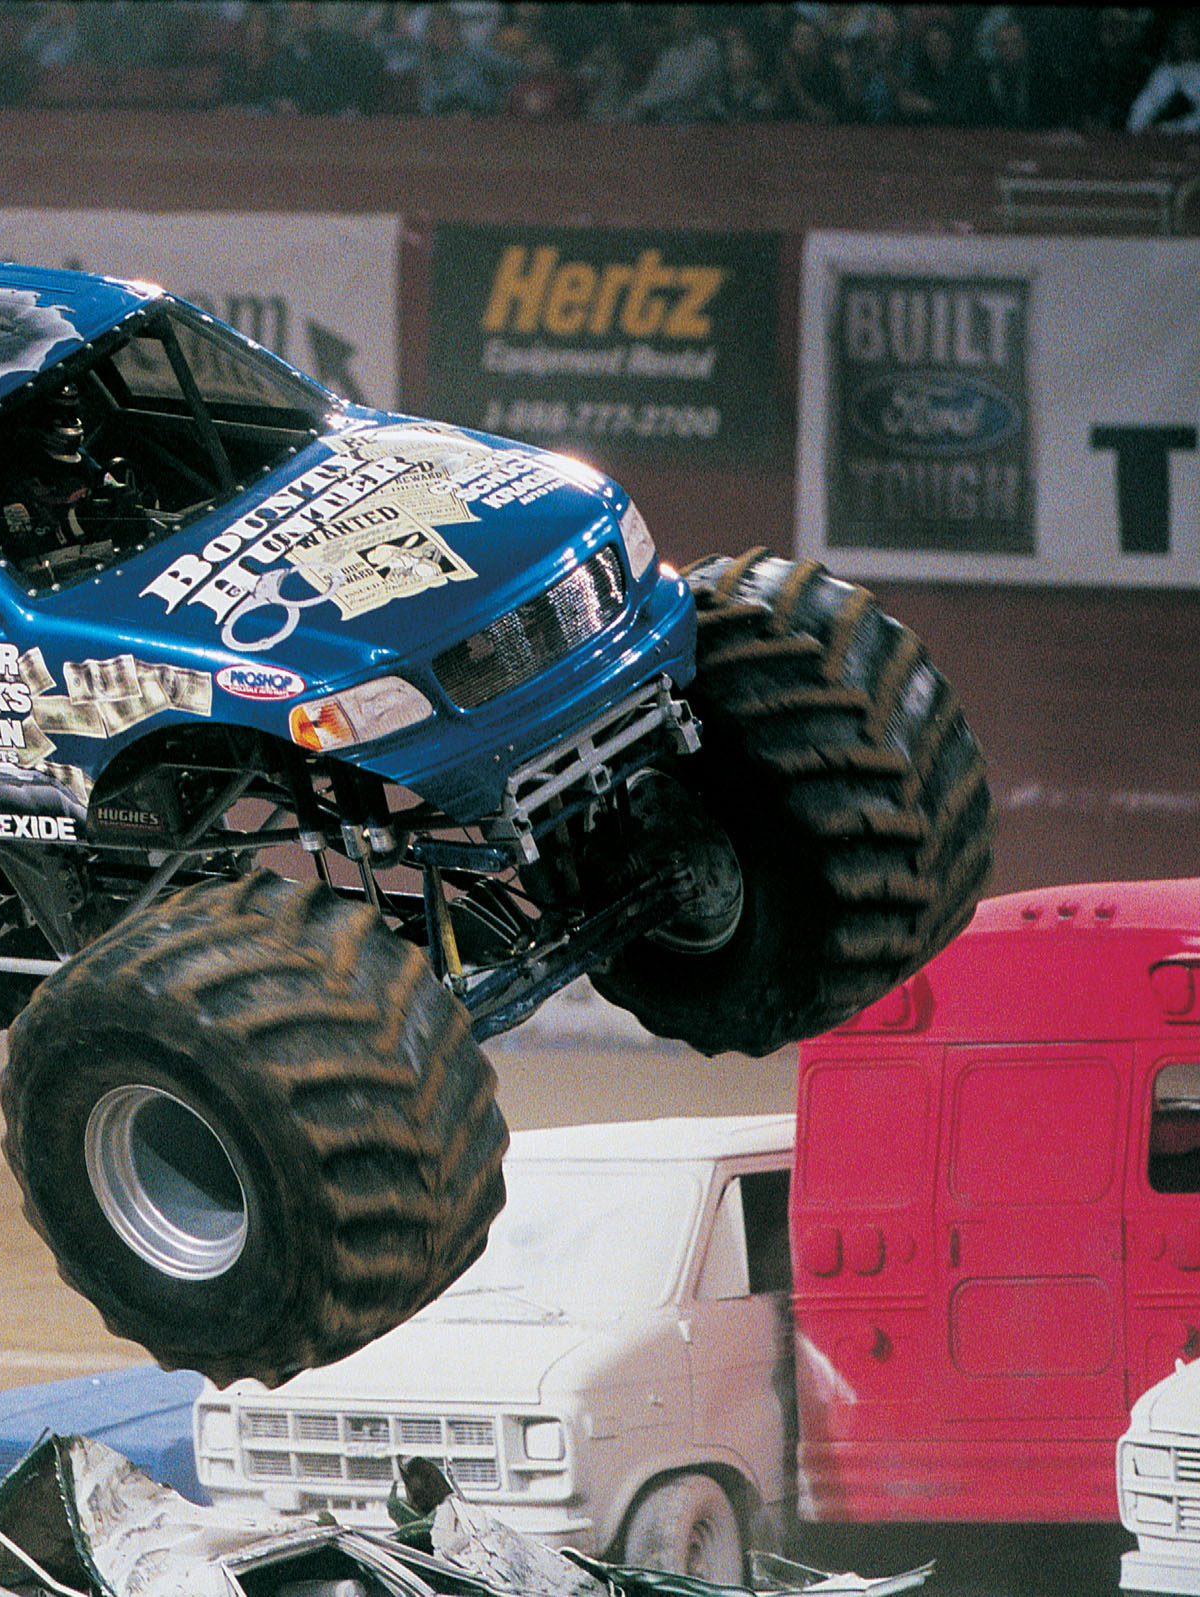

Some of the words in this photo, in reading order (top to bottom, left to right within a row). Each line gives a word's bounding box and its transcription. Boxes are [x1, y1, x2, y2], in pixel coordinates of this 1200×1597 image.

[482, 245, 725, 337] Hertz
[846, 291, 1016, 364] BUILT
[880, 385, 987, 439] Ford
[848, 462, 1018, 522] TOUGH
[1091, 423, 1198, 554] T
[138, 450, 369, 616] BOUNTY
[186, 456, 414, 626] HUNTER
[296, 506, 400, 550] WANTED
[230, 670, 293, 690] PROSHOP
[97, 807, 161, 826] HUGHES
